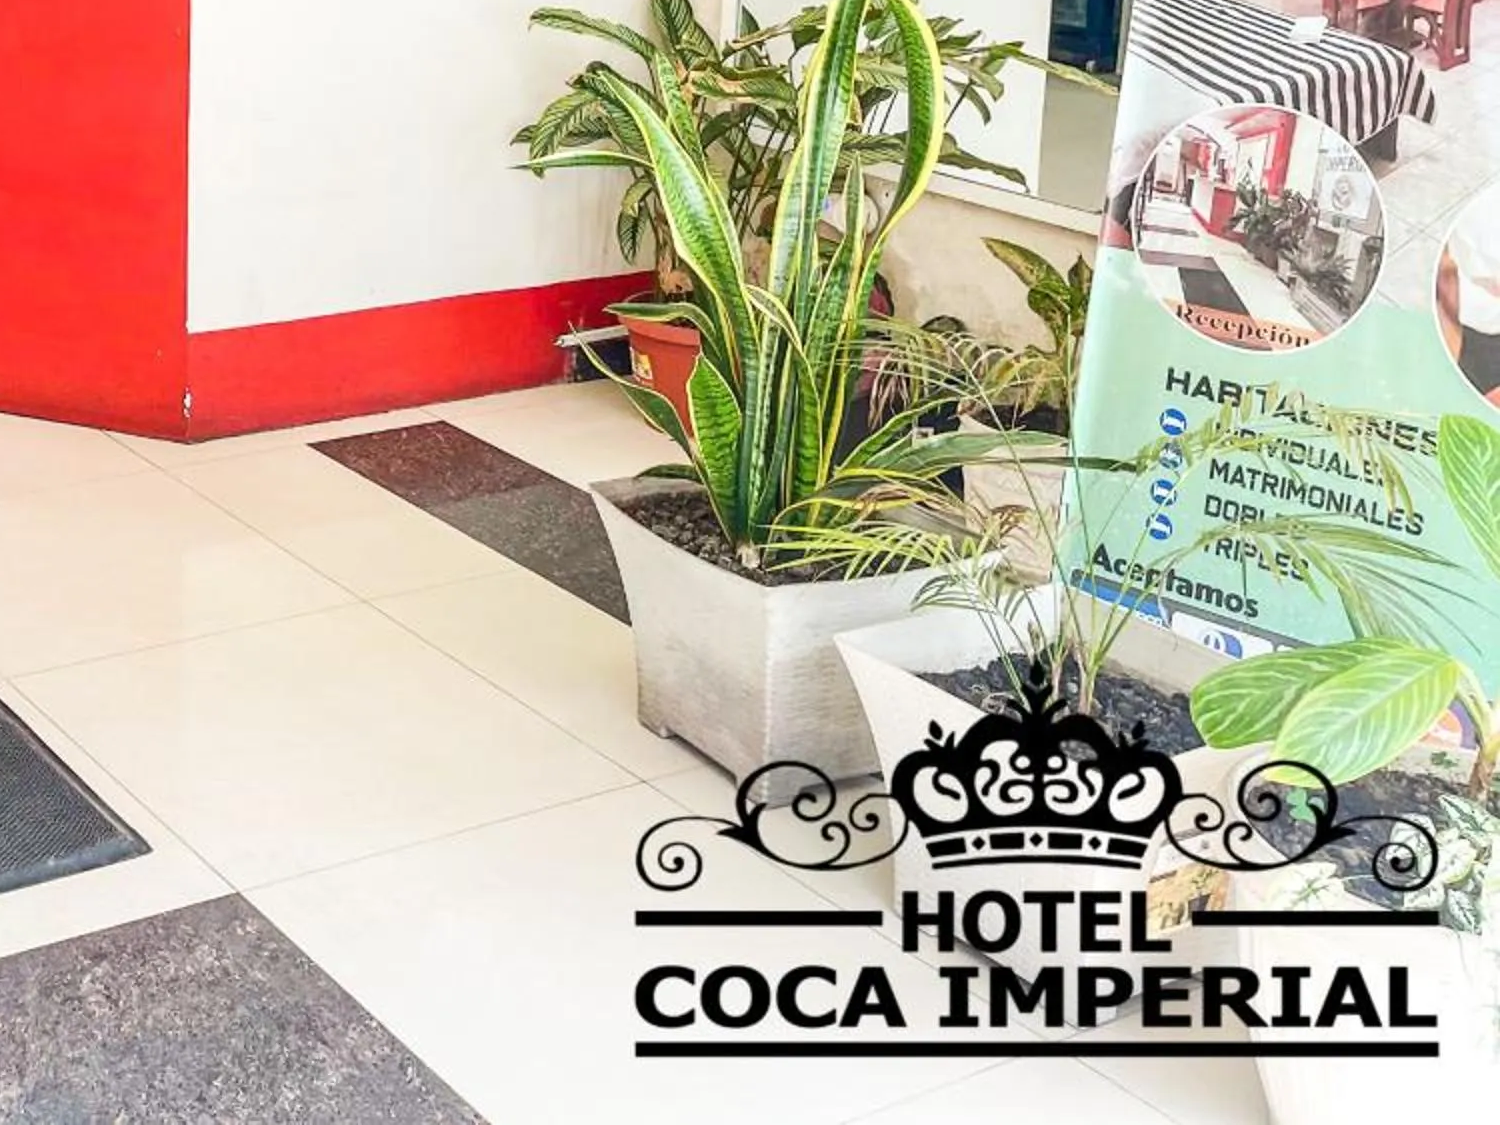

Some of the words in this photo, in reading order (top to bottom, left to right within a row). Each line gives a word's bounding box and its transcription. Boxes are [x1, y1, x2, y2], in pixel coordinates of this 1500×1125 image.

[1175, 304, 1310, 348] Recepción
[1208, 458, 1425, 537] MATRIMONIALES
[1092, 542, 1259, 618] Aceptamos
